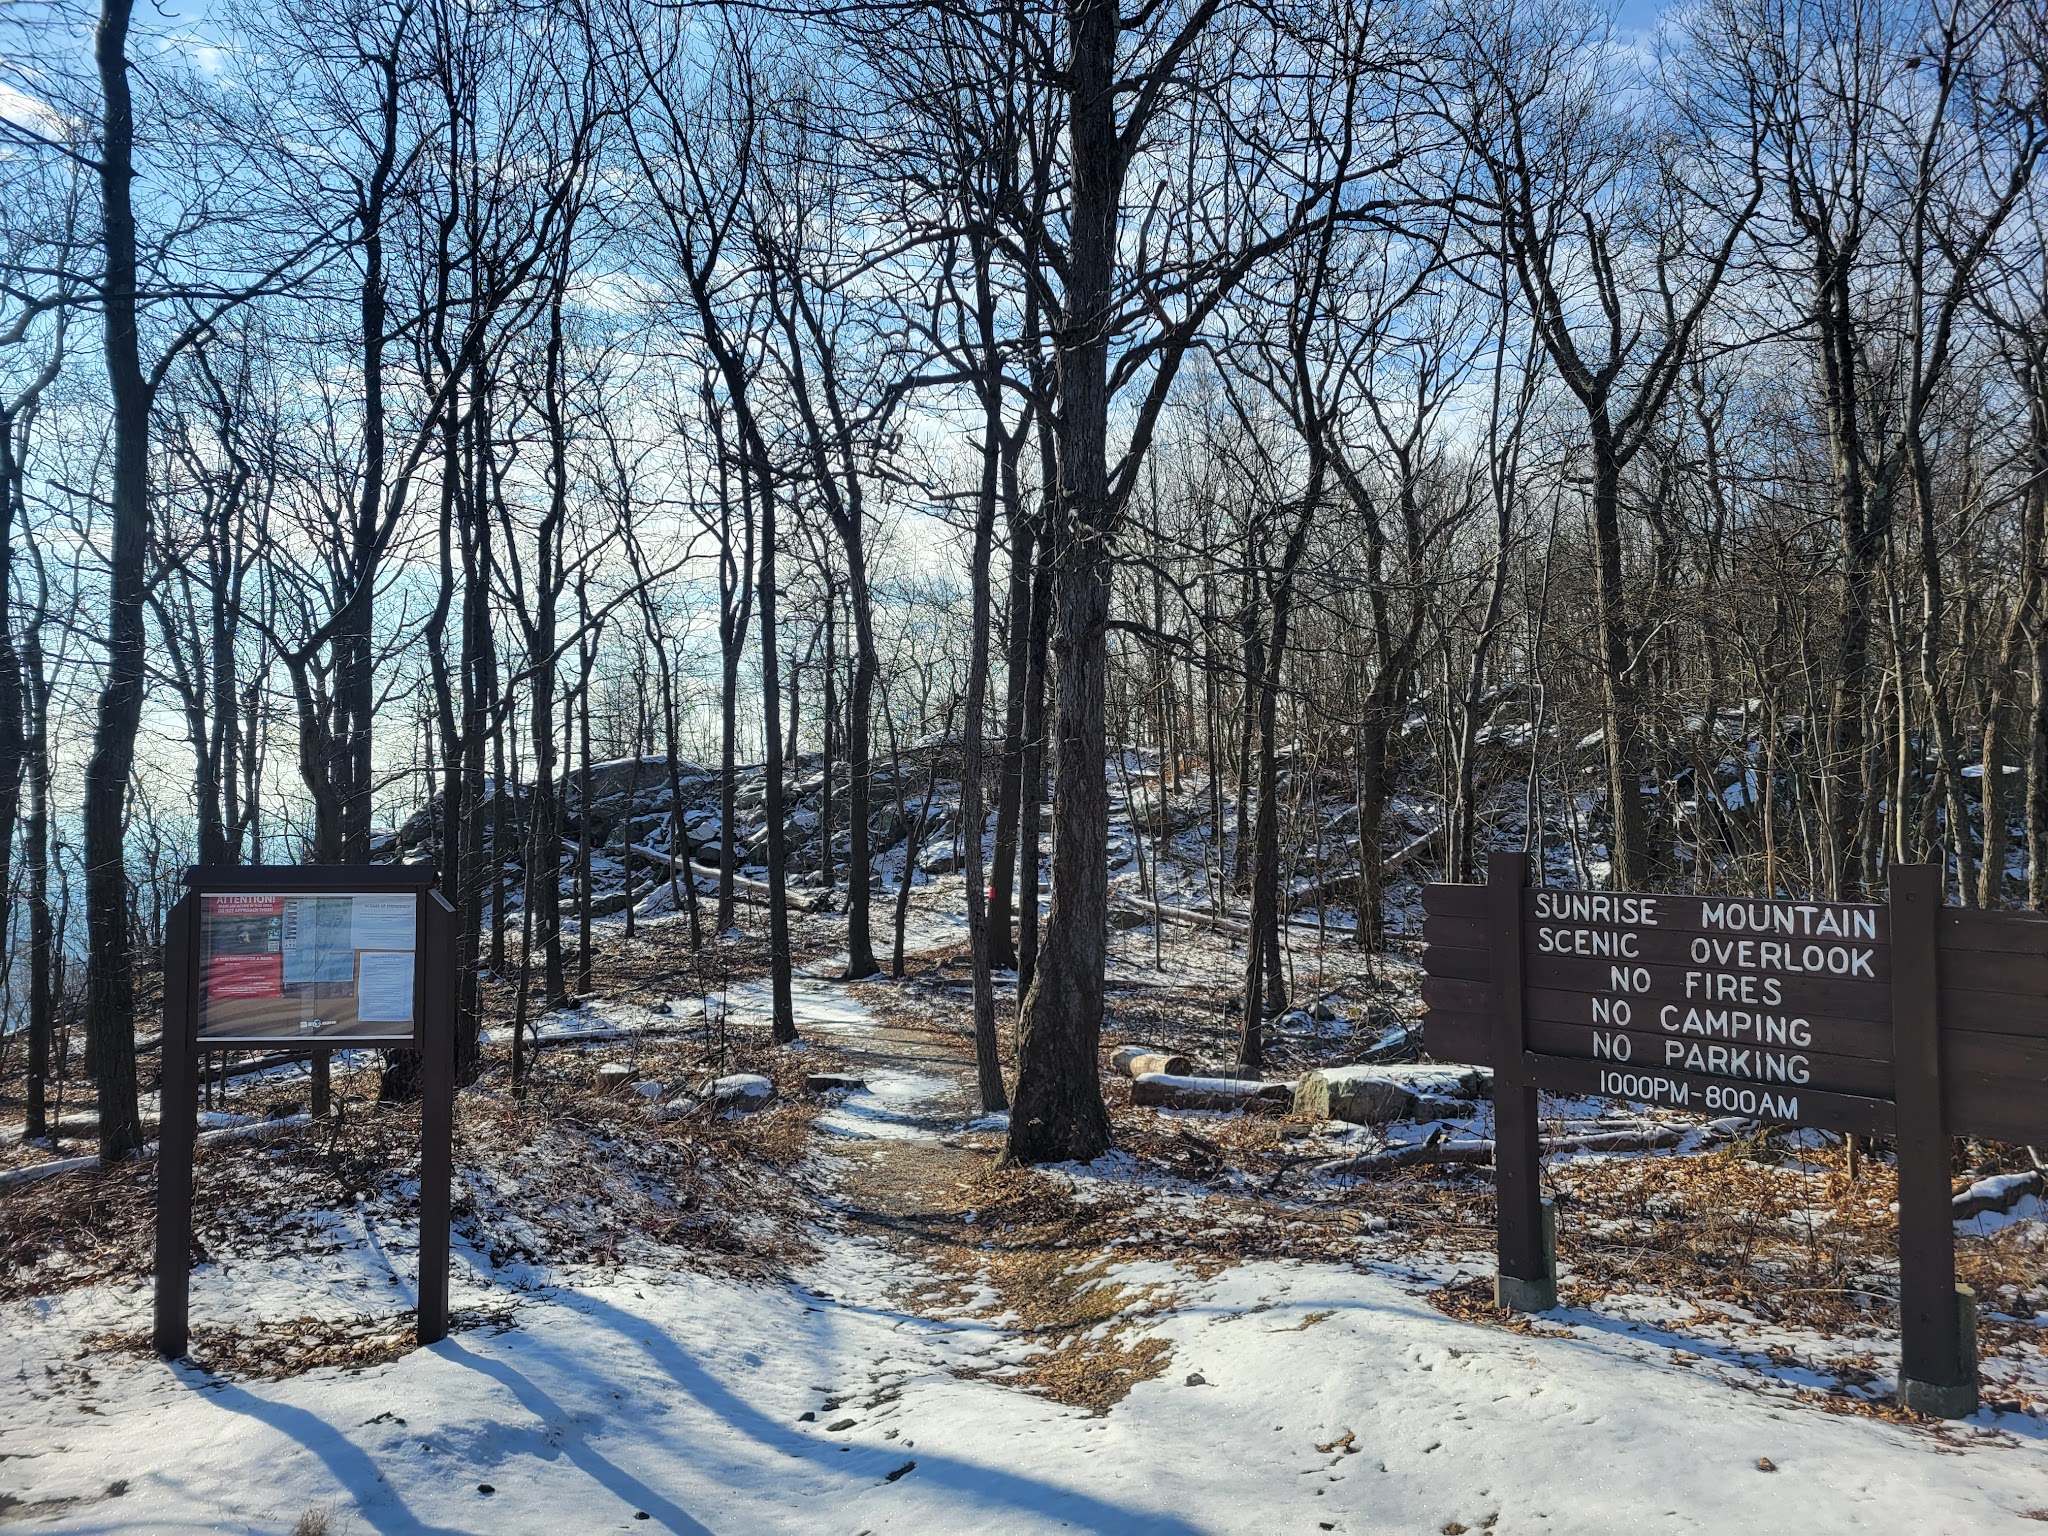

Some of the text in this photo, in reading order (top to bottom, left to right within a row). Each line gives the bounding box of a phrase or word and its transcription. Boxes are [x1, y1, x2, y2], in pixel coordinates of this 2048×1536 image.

[1534, 893, 1876, 939] SUNRISE MOUNTAIN
[1538, 927, 1875, 978] SCENIC OVERLOOK
[1611, 965, 1782, 1006] NO FIRES
[1592, 997, 1812, 1047] NO CAMPING
[1593, 1031, 1810, 1084] NO PARKING
[1600, 1070, 1798, 1121] 1000PM-800AM
